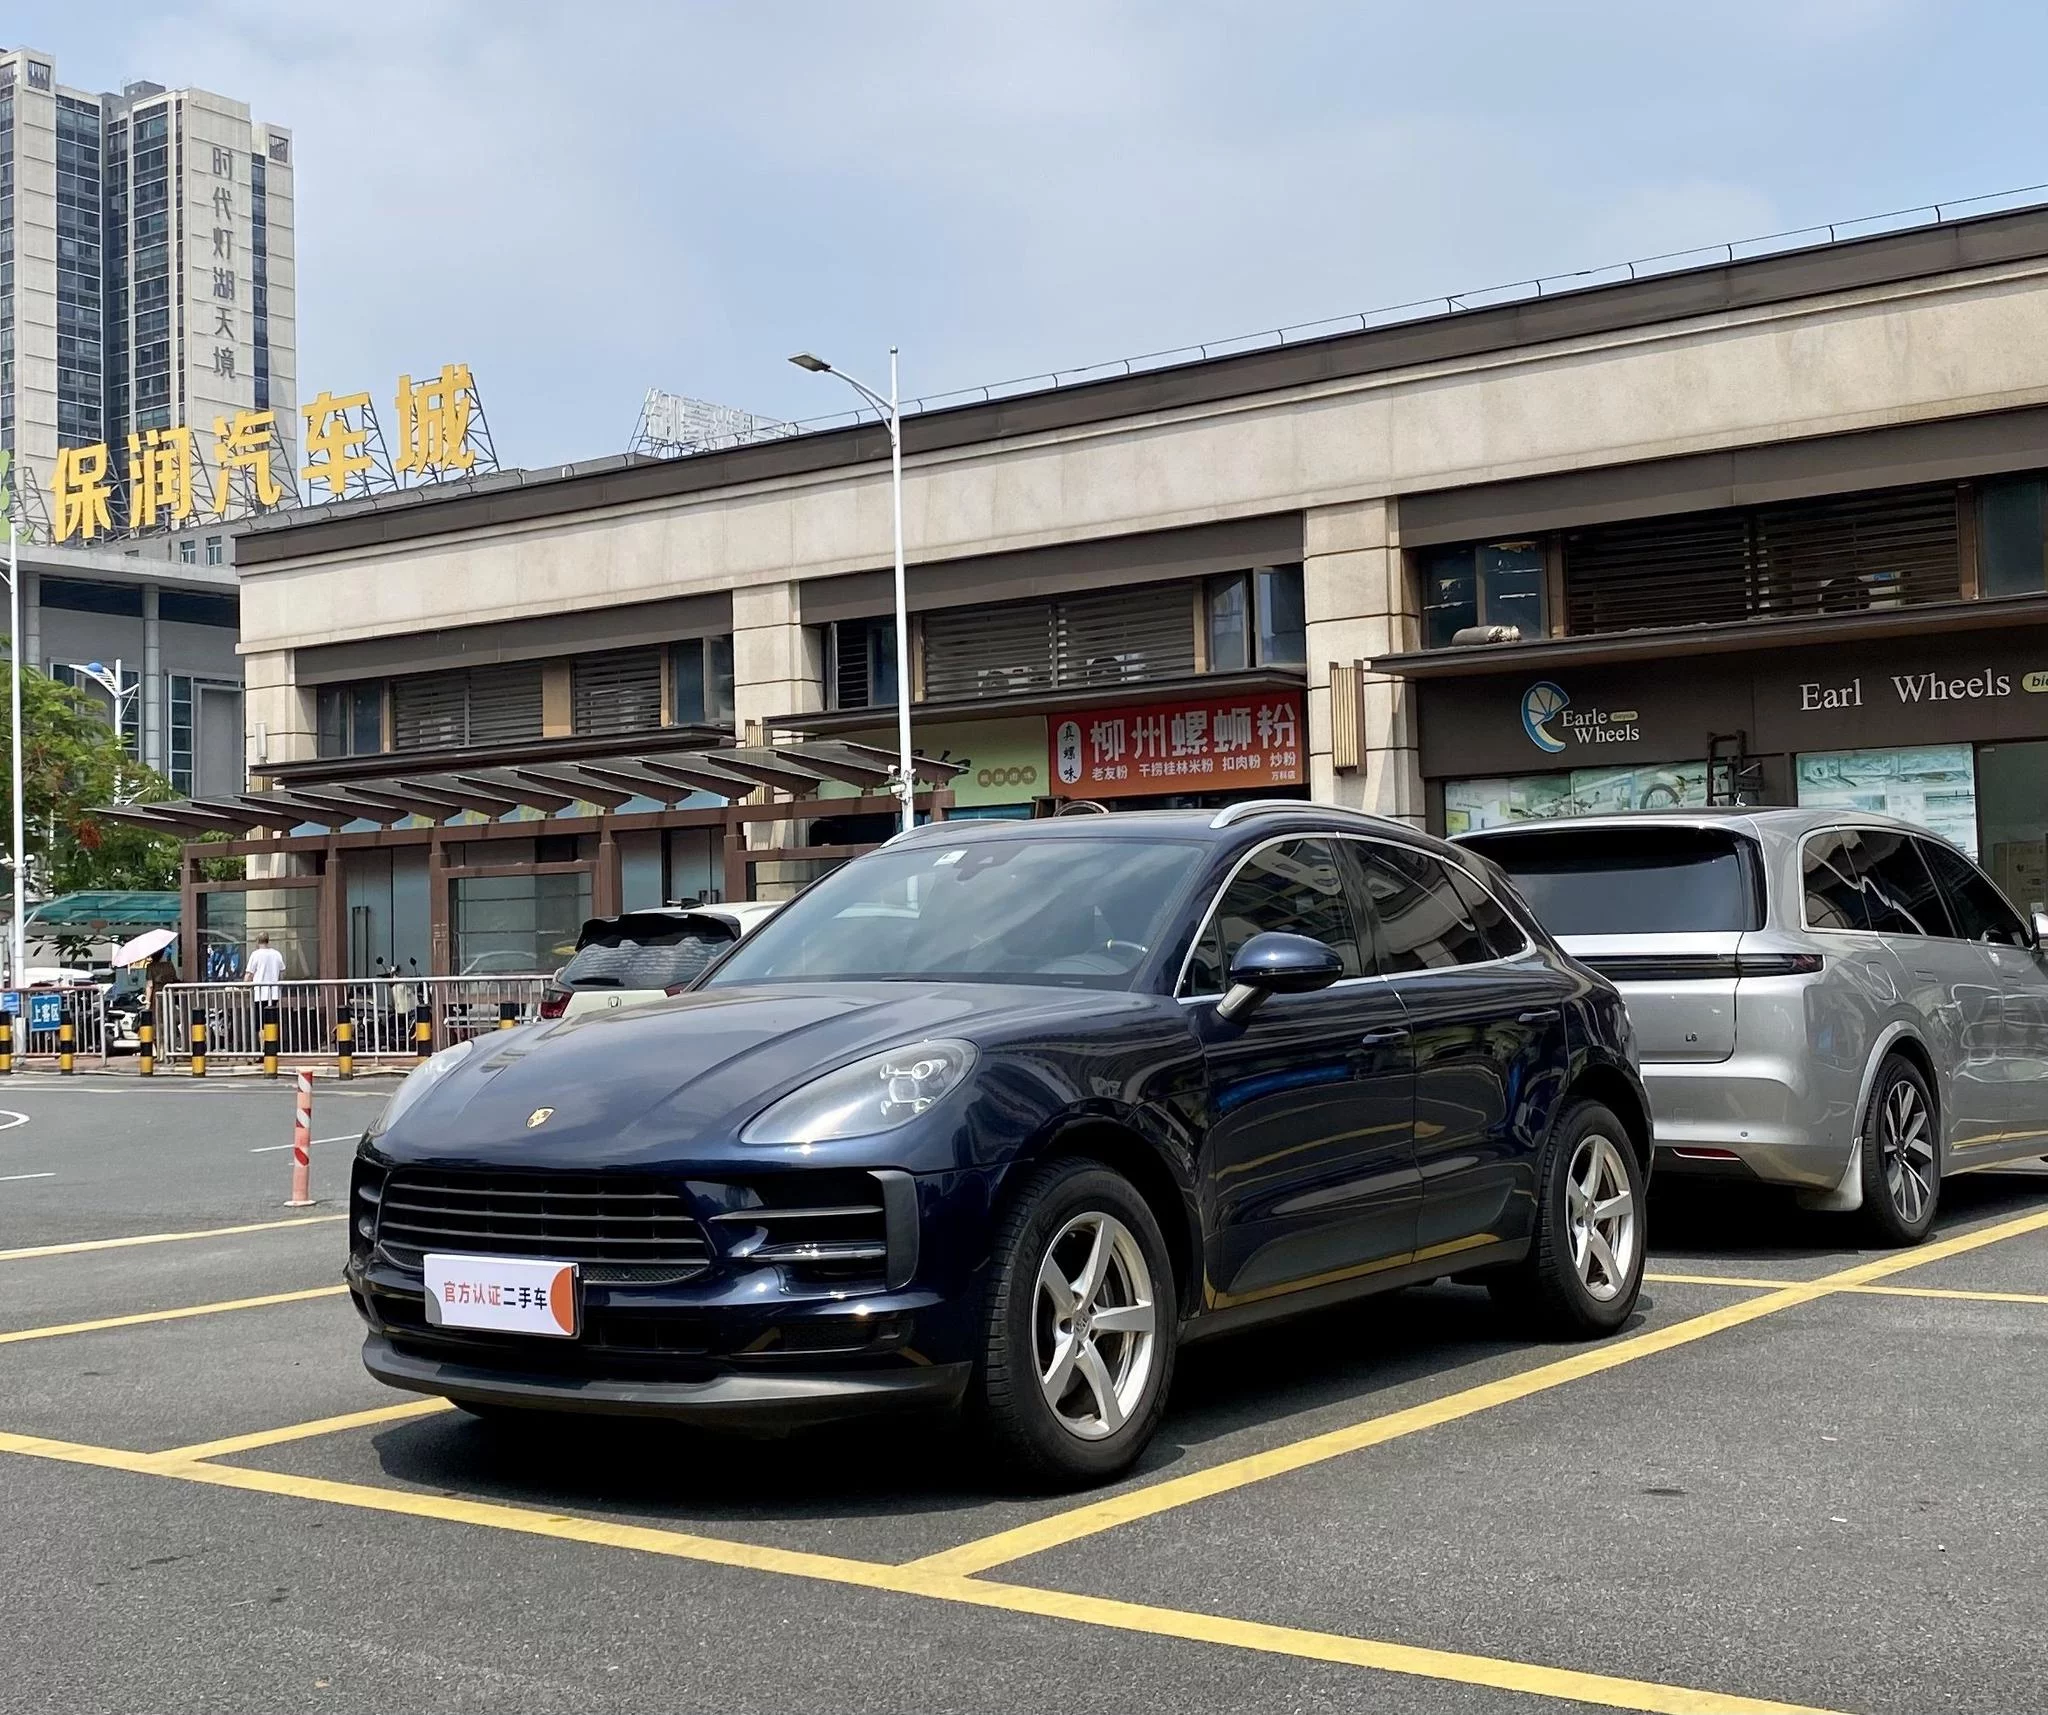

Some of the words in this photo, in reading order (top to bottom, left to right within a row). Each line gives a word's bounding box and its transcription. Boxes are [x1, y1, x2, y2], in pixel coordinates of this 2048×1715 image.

[212, 146, 237, 380] 时代灯湖天境
[49, 363, 476, 543] 保润汽车城
[1799, 678, 1864, 711] Earl
[1890, 667, 2012, 704] Wheels
[1089, 702, 1296, 764] 柳州螺蛳粉
[1561, 708, 1608, 727] Earle
[1573, 724, 1640, 744] Wheels
[1062, 722, 1077, 782] 真螺味
[1091, 765, 1128, 781] 老友粉
[1139, 758, 1214, 777] 干捞桂林米粉
[1222, 754, 1261, 771] 扣肉粉
[1270, 751, 1296, 768] 炒粉
[33, 1003, 60, 1023] 上客区
[443, 1280, 548, 1311] 官方认证二手车
